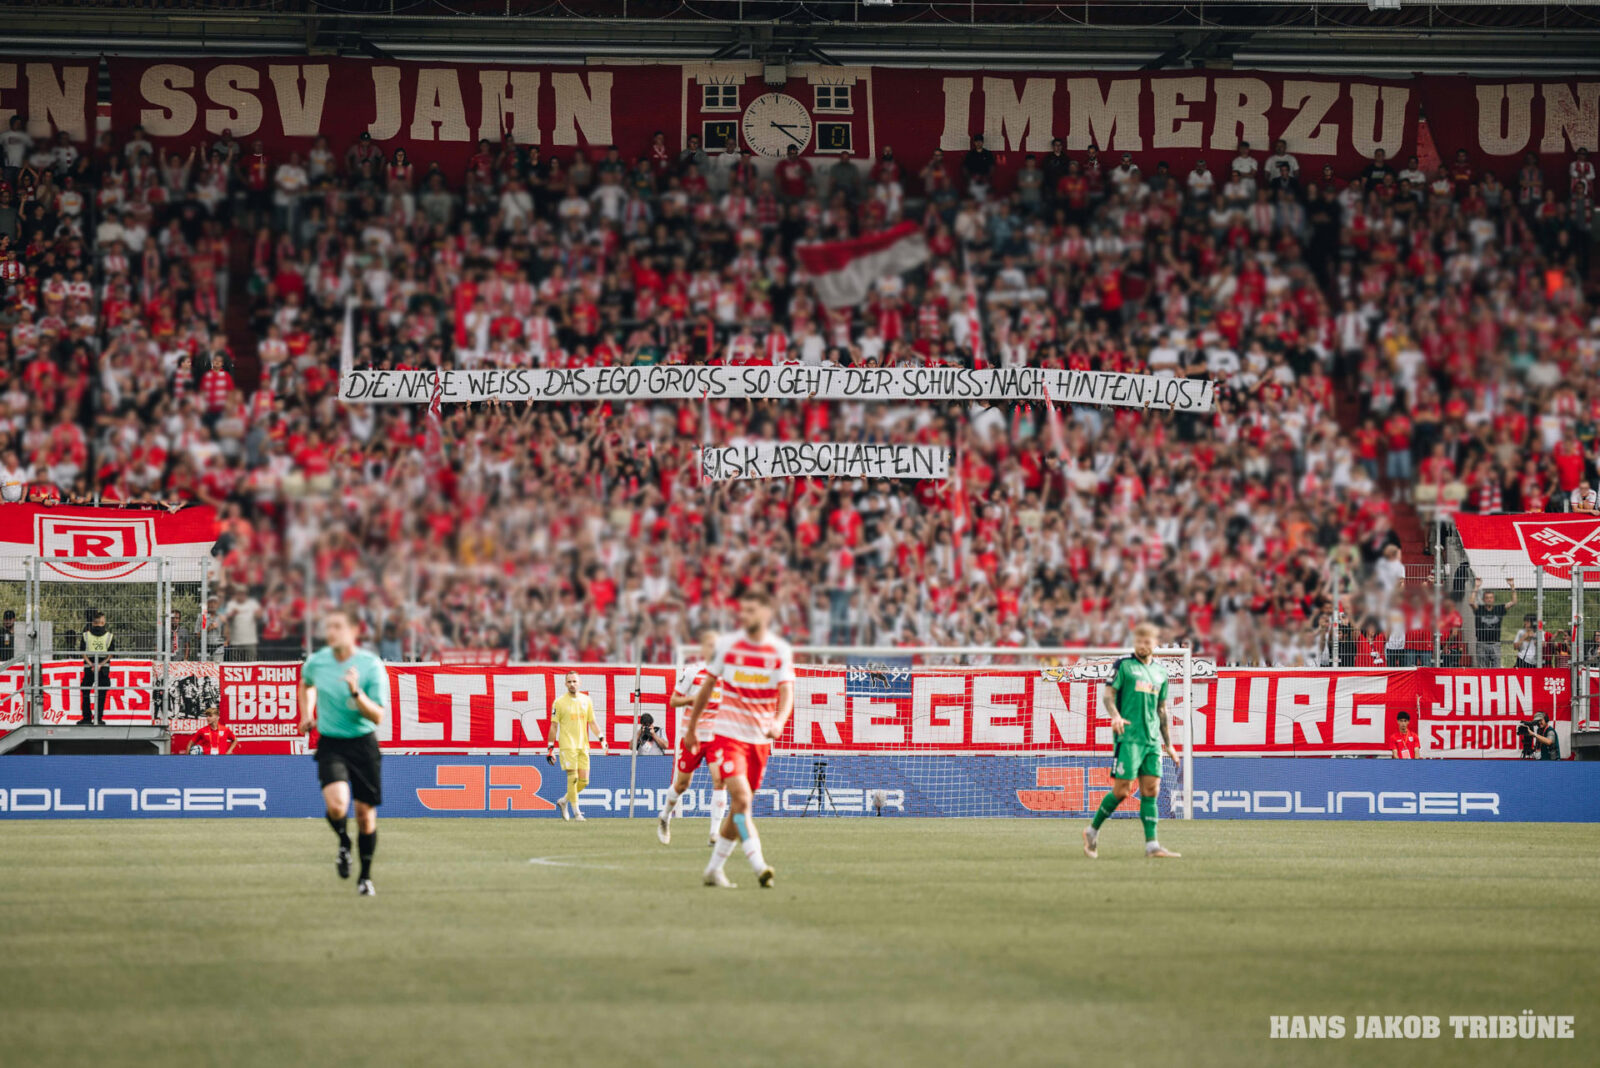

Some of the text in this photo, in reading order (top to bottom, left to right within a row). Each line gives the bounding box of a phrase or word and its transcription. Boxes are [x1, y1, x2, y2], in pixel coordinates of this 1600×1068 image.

[140, 64, 329, 137] SSV
[367, 66, 613, 145] JAHN
[940, 76, 1410, 159] IMMERZU
[396, 370, 457, 399] NASE
[543, 368, 591, 396] DAS
[596, 366, 642, 394] EGO
[648, 366, 727, 395] GROSS
[742, 367, 772, 394] SO
[778, 368, 841, 395] GEHT
[844, 369, 893, 395] DER
[902, 368, 983, 397] SCHUSS
[989, 368, 1045, 397] NACH
[223, 666, 297, 682] SSV JAHN
[223, 684, 298, 721] 1889
[380, 673, 667, 742] LTRS
[1431, 674, 1534, 717] JAHN
